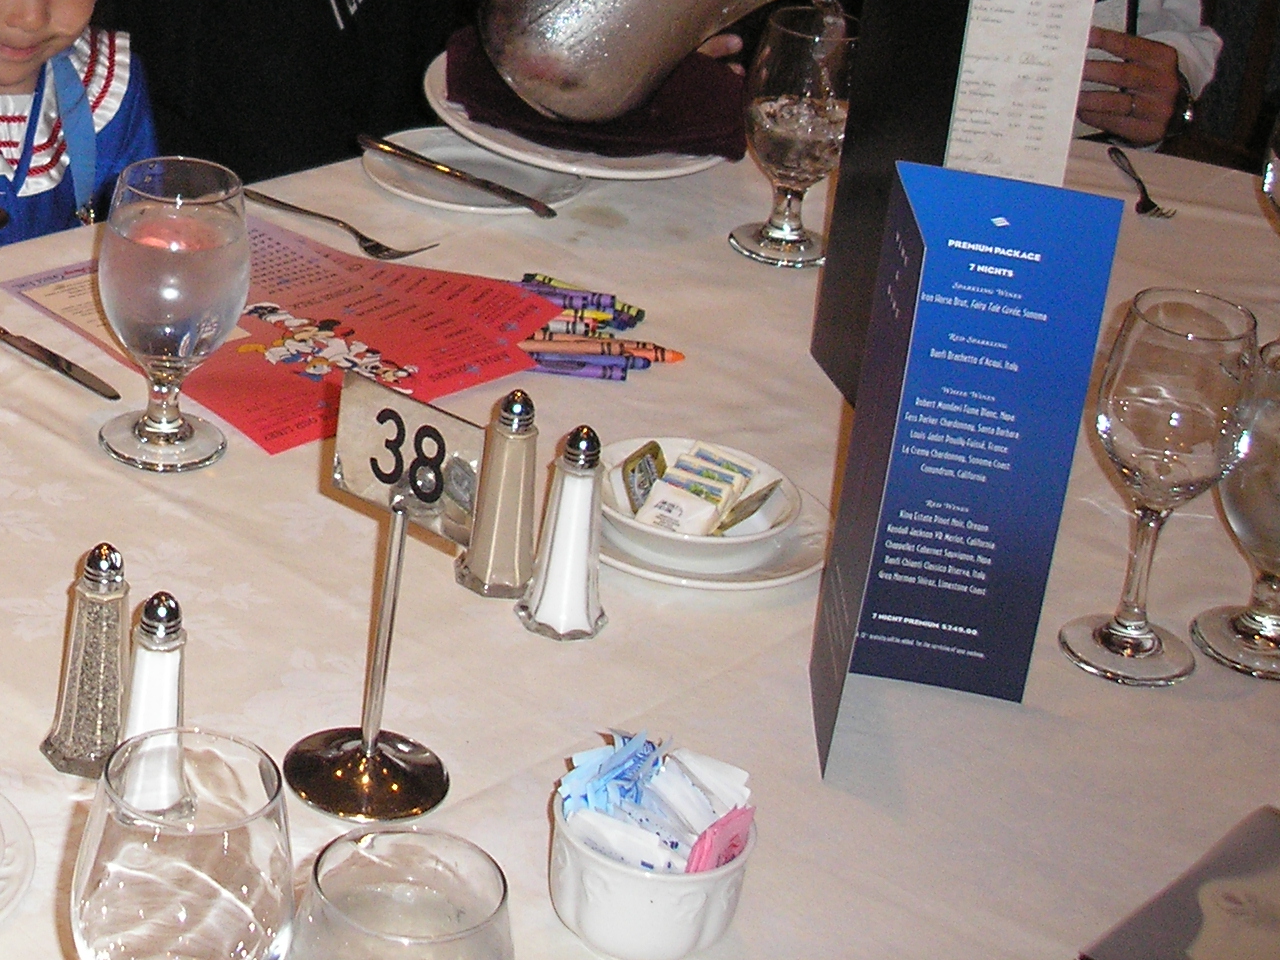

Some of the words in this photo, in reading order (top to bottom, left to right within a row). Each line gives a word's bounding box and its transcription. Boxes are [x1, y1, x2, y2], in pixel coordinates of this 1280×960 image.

[948, 239, 993, 253] PREMIUM
[993, 246, 1041, 261] PACKAGE
[968, 262, 975, 270] 7
[977, 264, 1013, 276] NIGHTS
[934, 294, 952, 305] Horse
[970, 299, 987, 310] Fairy
[915, 397, 935, 408] Robert
[909, 430, 926, 440] Louis
[977, 423, 995, 434] Santa
[995, 426, 1019, 439] Barbara
[370, 408, 446, 503] 38
[992, 459, 1010, 470] Coast
[956, 469, 987, 483] California
[913, 511, 932, 523] Estate
[965, 537, 995, 549] California
[915, 544, 942, 557] Cabernet
[968, 584, 986, 596] Coast
[878, 612, 902, 623] NIGHT
[903, 616, 939, 629] PREMIUM
